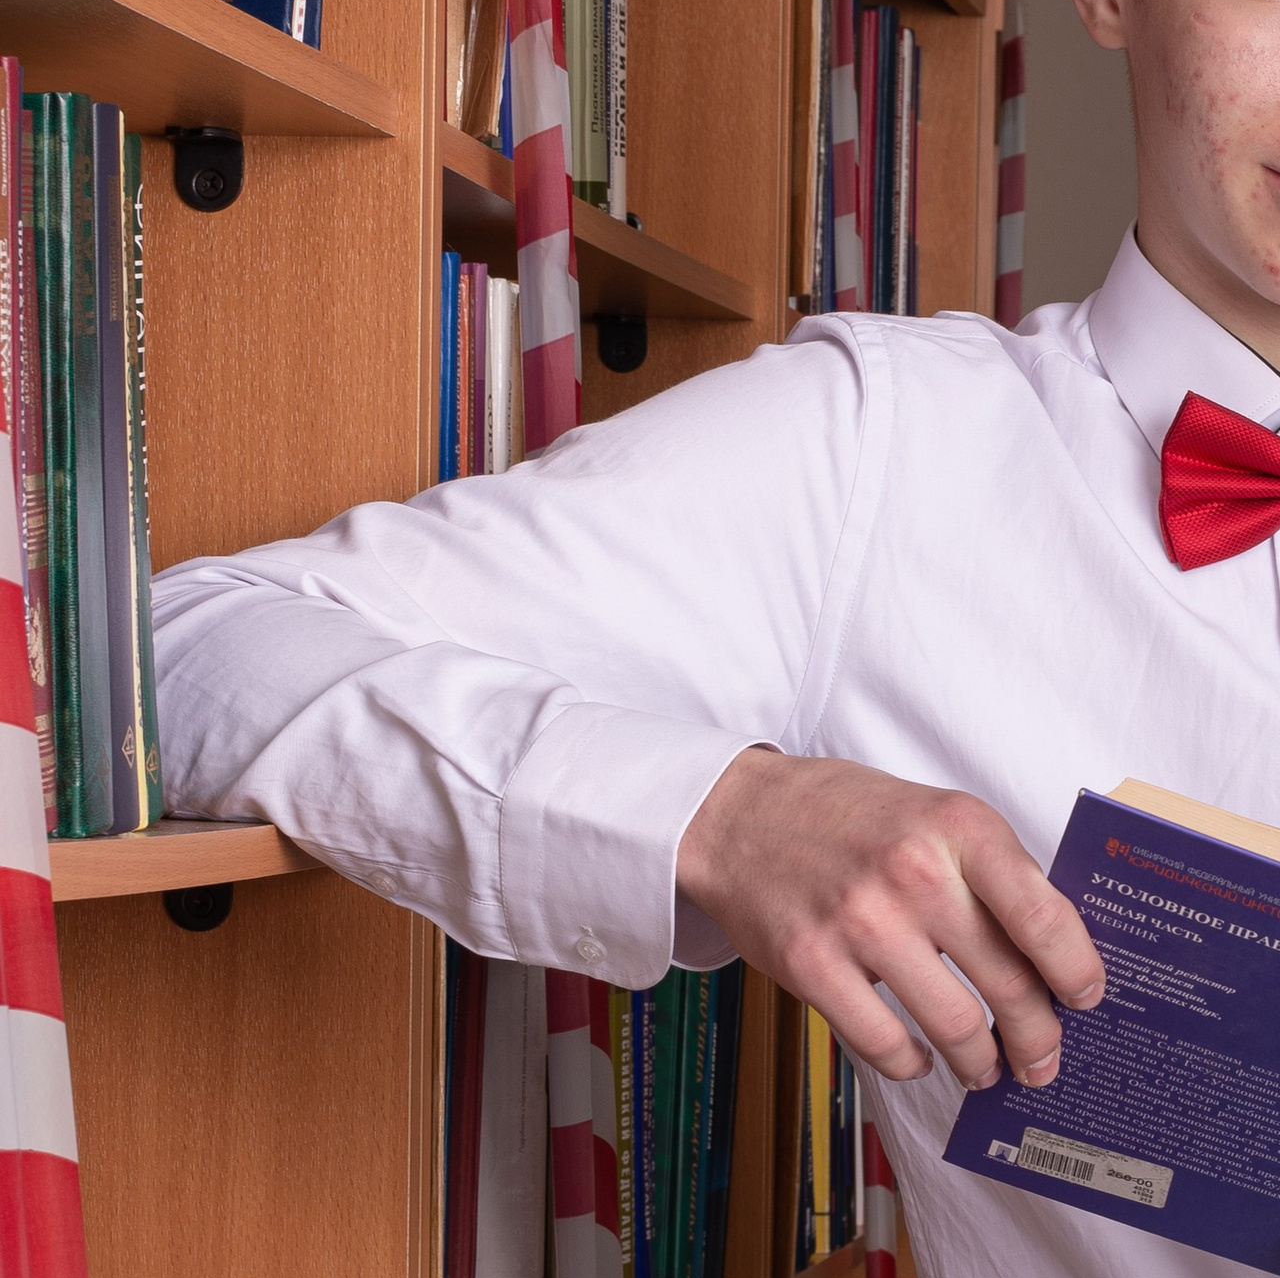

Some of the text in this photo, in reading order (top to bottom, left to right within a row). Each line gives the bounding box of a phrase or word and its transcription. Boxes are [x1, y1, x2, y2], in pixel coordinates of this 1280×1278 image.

[1126, 853, 1240, 903] ЮРИДИЧЕСКИЙ
[1130, 844, 1186, 872] СИБИРСКИЙ
[1185, 864, 1256, 897] ФЕДЕРАЛЬНЫЙ
[1076, 905, 1161, 943] УЧЕБНИК
[1080, 891, 1205, 944] ОБЩАЯ ЧАСТЬ
[1088, 871, 1226, 930] УГОЛОВНОЕ
[1134, 972, 1210, 1006] Федерации,
[1150, 969, 1195, 991] юрист
[1173, 966, 1237, 996] редактор
[1187, 1002, 1223, 1021] наук,
[1064, 1028, 1137, 1060] стандартом
[1160, 1061, 1198, 1081] курсу
[1202, 1074, 1277, 1106] «Уголовное
[1081, 1024, 1165, 1058] соответствии
[1114, 1026, 1152, 1046] права
[1154, 1039, 1232, 1073] Сибирского
[1117, 1017, 1169, 1040] написан
[1174, 1038, 1242, 1067] авторским
[1064, 1064, 1122, 1090] Учебный
[1124, 1087, 1183, 1113] материал
[1187, 1108, 1241, 1131] изложен
[1078, 1041, 1166, 1079] обучающихся
[1185, 1079, 1280, 1117] специальности
[1090, 1065, 1122, 1081] темы
[1126, 1076, 1172, 1098] Общей
[1176, 1095, 1212, 1111] части
[1153, 1076, 1221, 1107] Структура
[619, 1013, 631, 1264] РОССИЙСКОЙ ФЕДЕРАЦИИ
[1001, 1100, 1034, 1116] всем,
[1035, 1111, 1057, 1123] кто
[1057, 1119, 1137, 1152] интересуется
[1136, 1146, 1219, 1180] современным
[1004, 1092, 1085, 1125] юридических
[1085, 1117, 1164, 1152] факультетов
[1175, 1150, 1213, 1169] вузов,
[1225, 1167, 1261, 1183] также
[1019, 1086, 1072, 1110] Учебник
[1073, 1106, 1155, 1140] предназначен
[1157, 1135, 1181, 1148] для
[1181, 1143, 1243, 1170] студентов
[1058, 1092, 1254, 1164] материалов судебной практики.
[1061, 1084, 1119, 1110] развития
[1123, 1105, 1167, 1126] теории
[1169, 1120, 1240, 1151] уголовного
[1087, 1081, 1155, 1110] новейшего
[1159, 1107, 1272, 1151] законодательства,
